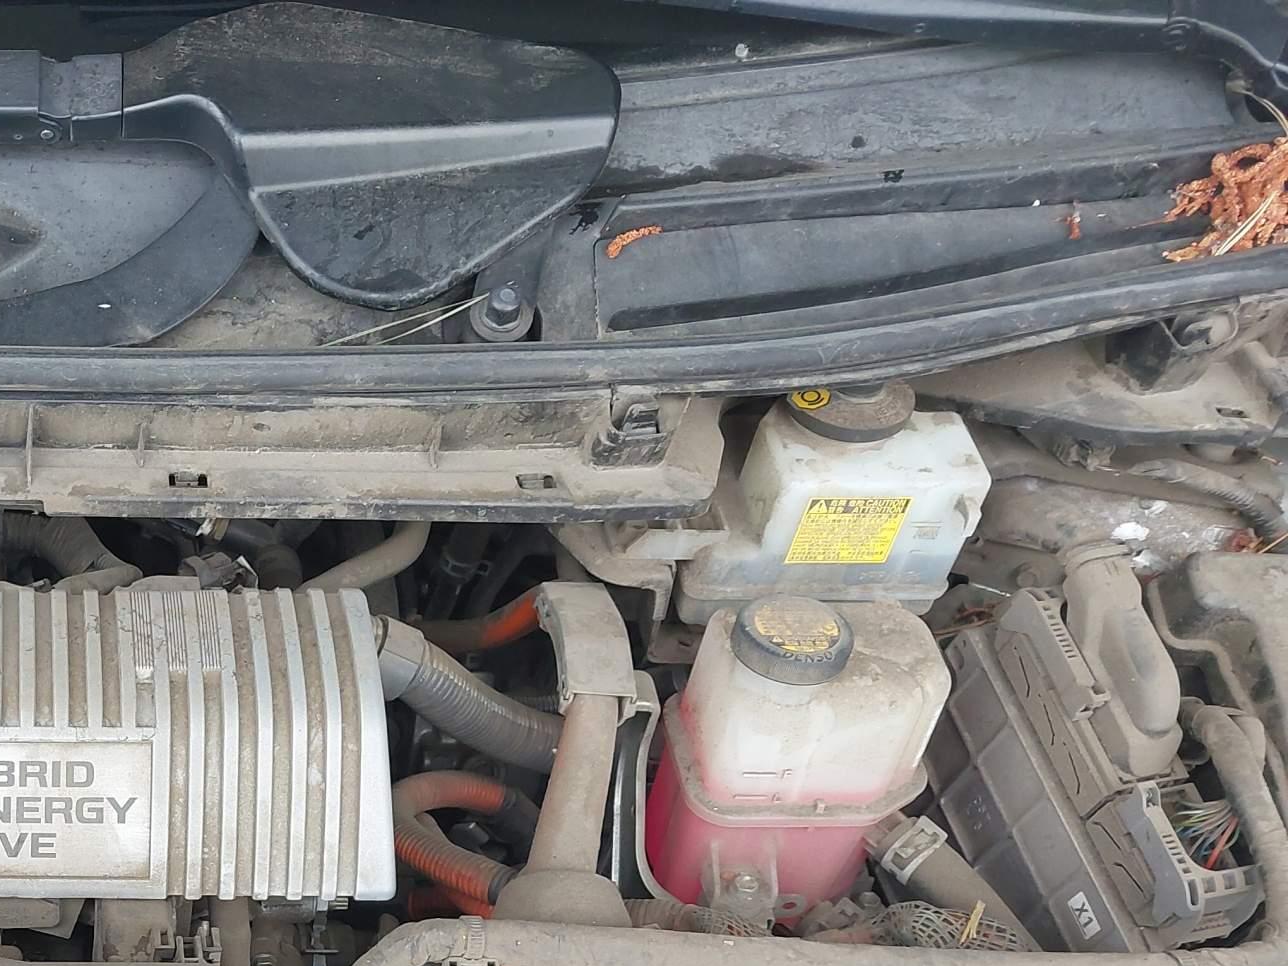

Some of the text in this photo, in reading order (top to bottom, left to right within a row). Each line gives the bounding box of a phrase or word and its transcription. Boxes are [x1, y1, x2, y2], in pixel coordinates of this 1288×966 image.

[866, 499, 906, 507] CAUTION
[852, 506, 904, 514] ATTENTION
[783, 651, 833, 663] DENSO
[1073, 901, 1093, 928] X1
